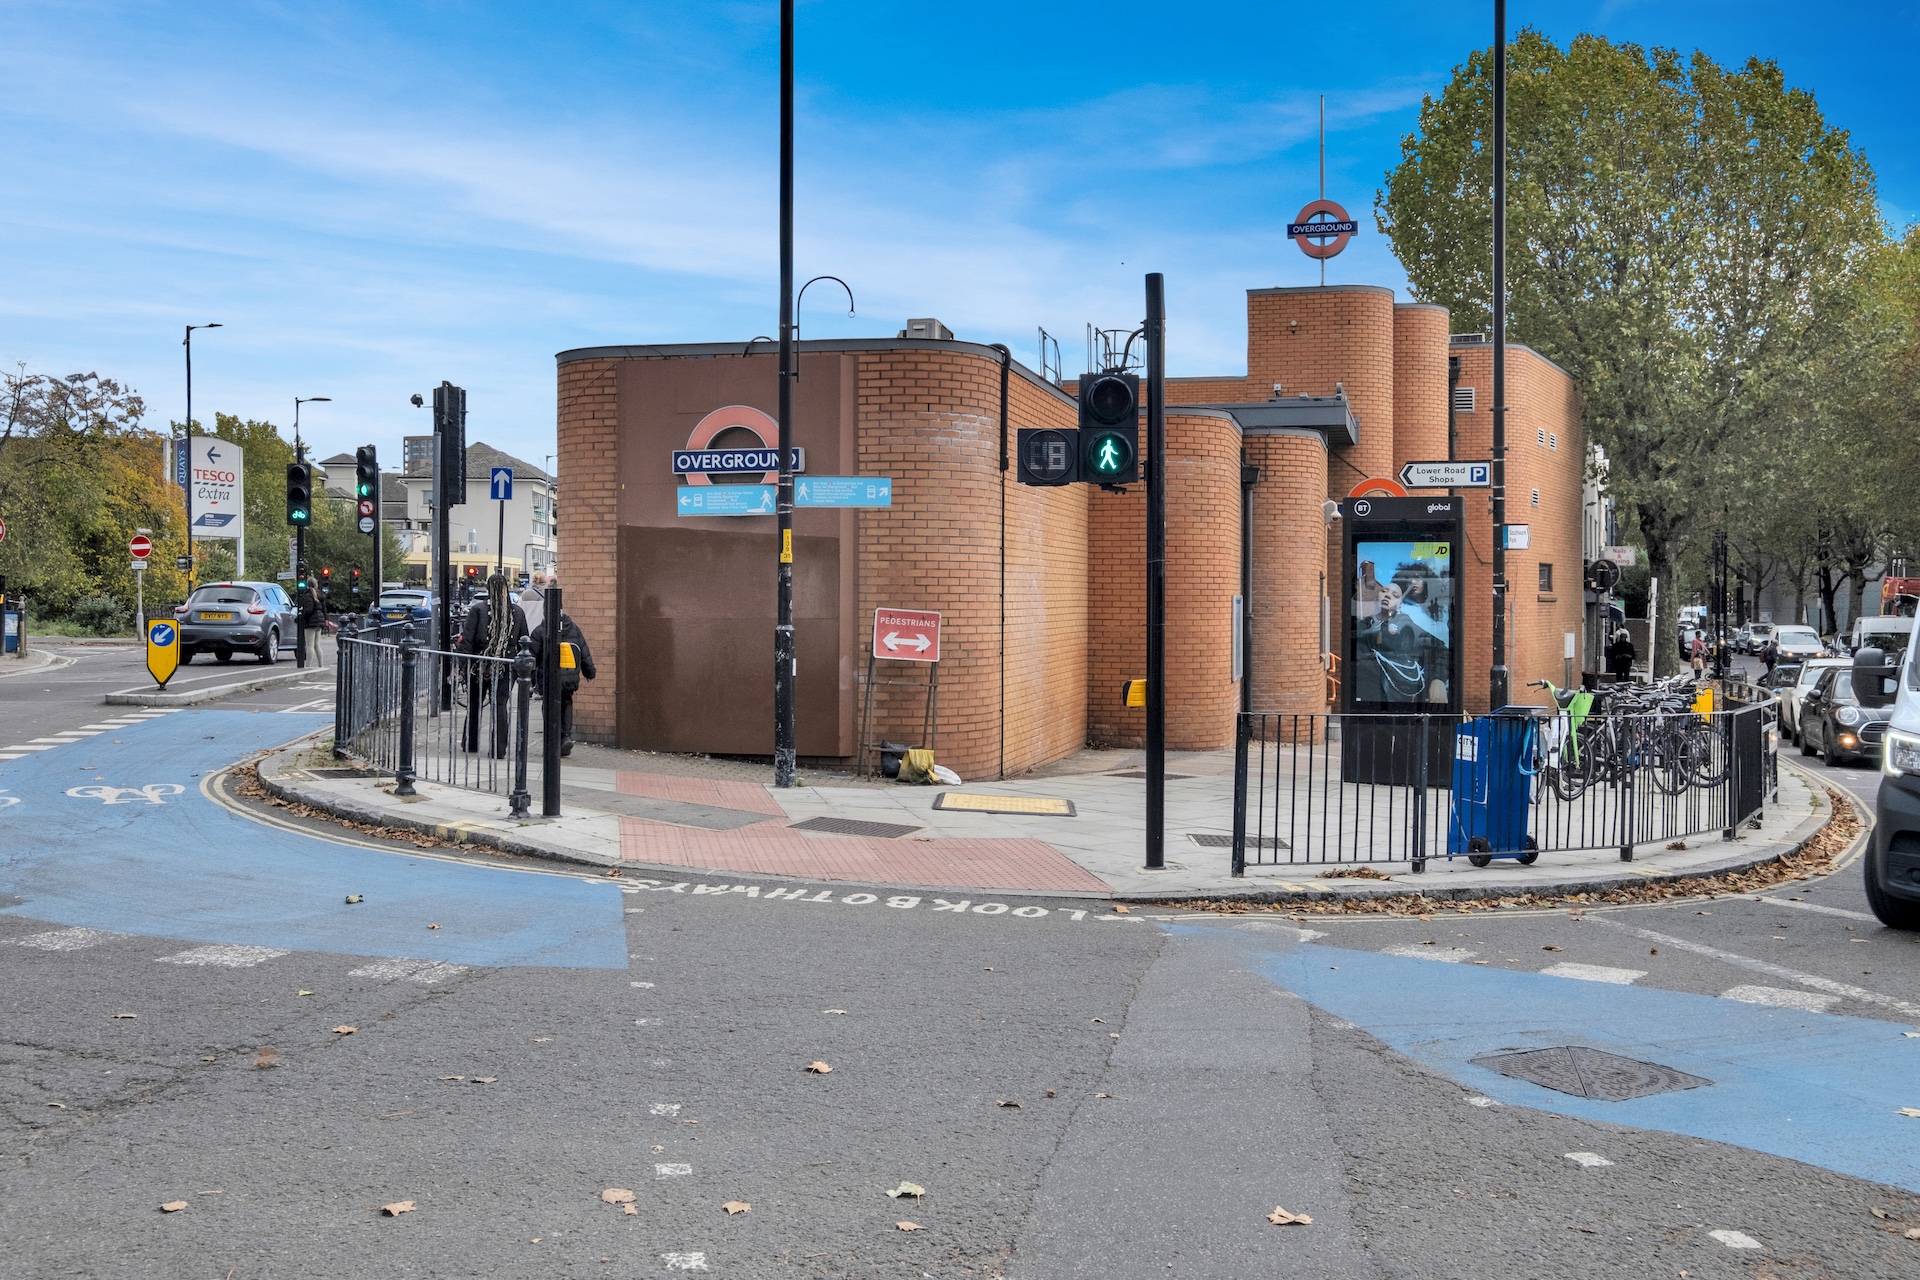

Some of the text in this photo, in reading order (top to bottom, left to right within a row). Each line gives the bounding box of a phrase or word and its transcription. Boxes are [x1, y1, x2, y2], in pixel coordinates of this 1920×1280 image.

[1292, 224, 1352, 233] OVERGROUND
[194, 469, 235, 482] TESCO
[1473, 468, 1484, 481] P
[198, 486, 230, 500] extra
[1427, 503, 1450, 513] global
[880, 617, 936, 628] PEDESTRIANS
[618, 880, 1088, 920] LOOK BOTH WAYS
